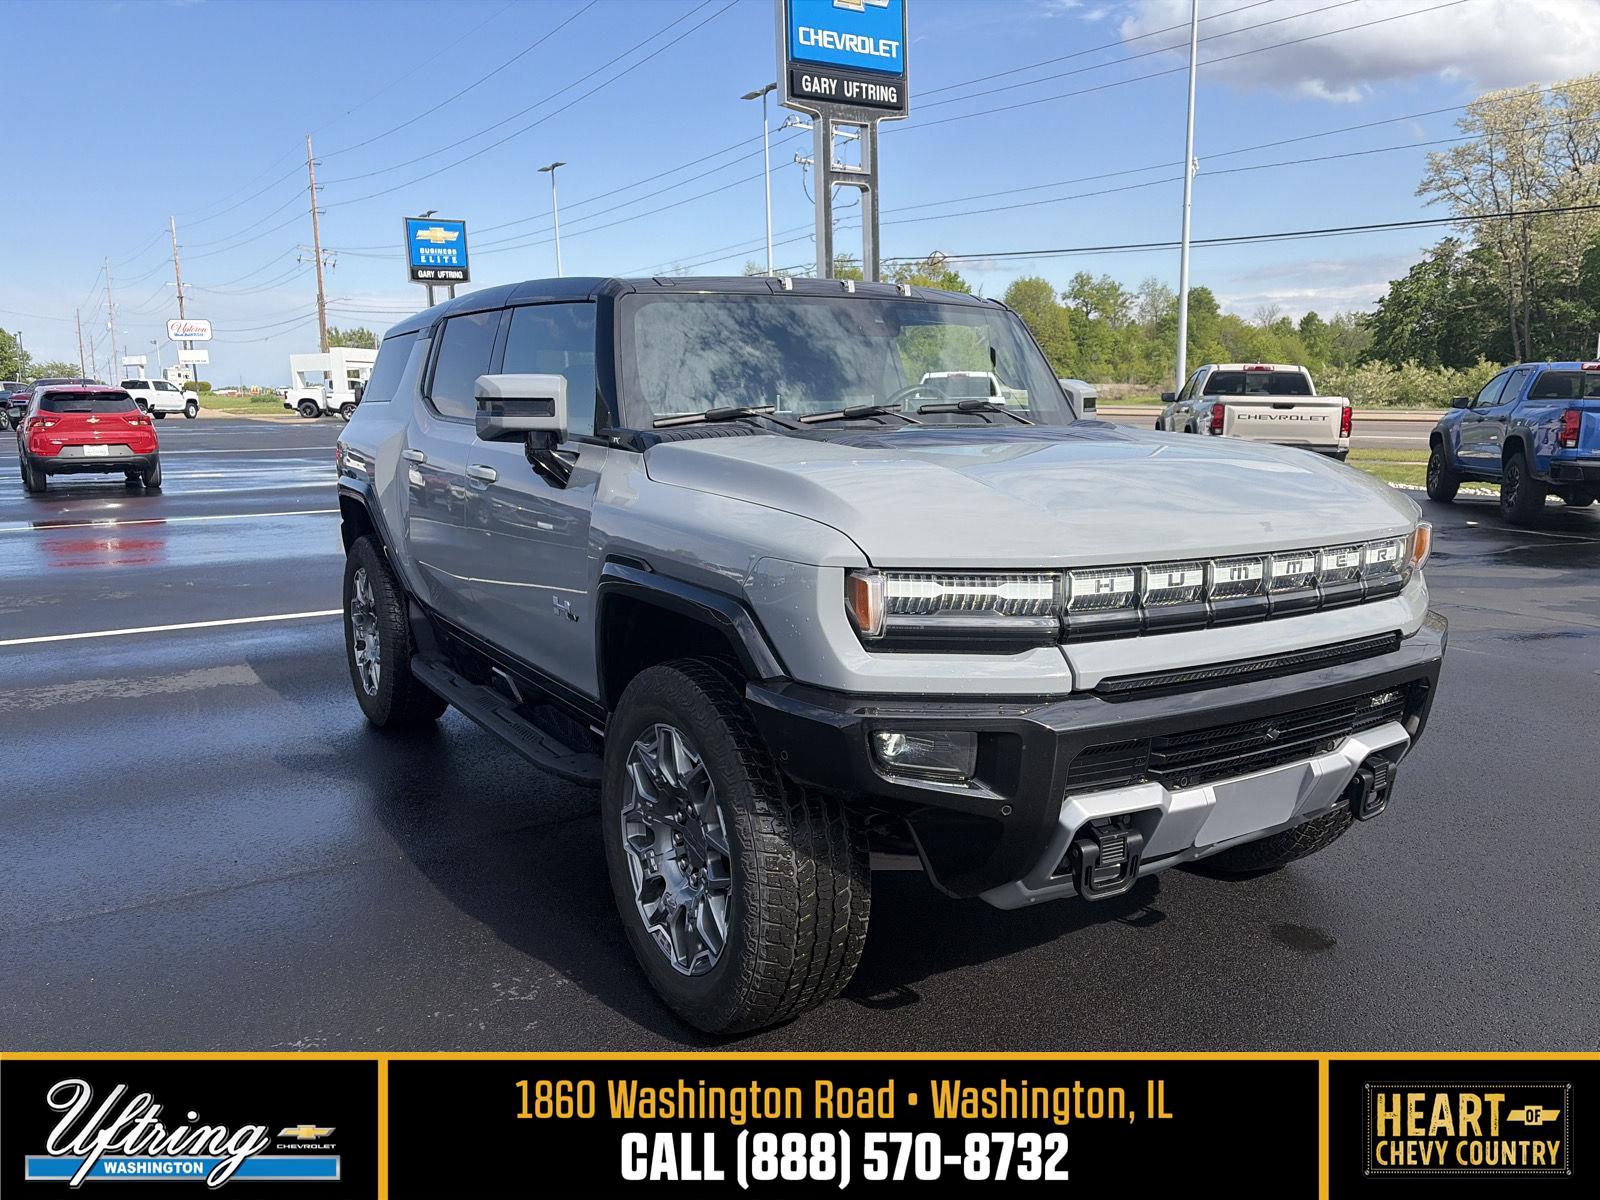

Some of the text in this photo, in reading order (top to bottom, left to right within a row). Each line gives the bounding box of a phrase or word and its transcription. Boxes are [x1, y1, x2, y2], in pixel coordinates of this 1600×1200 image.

[798, 26, 899, 58] CHEVROLET
[801, 75, 897, 103] GARY UFTRING
[418, 270, 463, 279] GARY UFTRING
[1237, 413, 1329, 422] CHEVROLET
[1094, 548, 1389, 594] HUMMER
